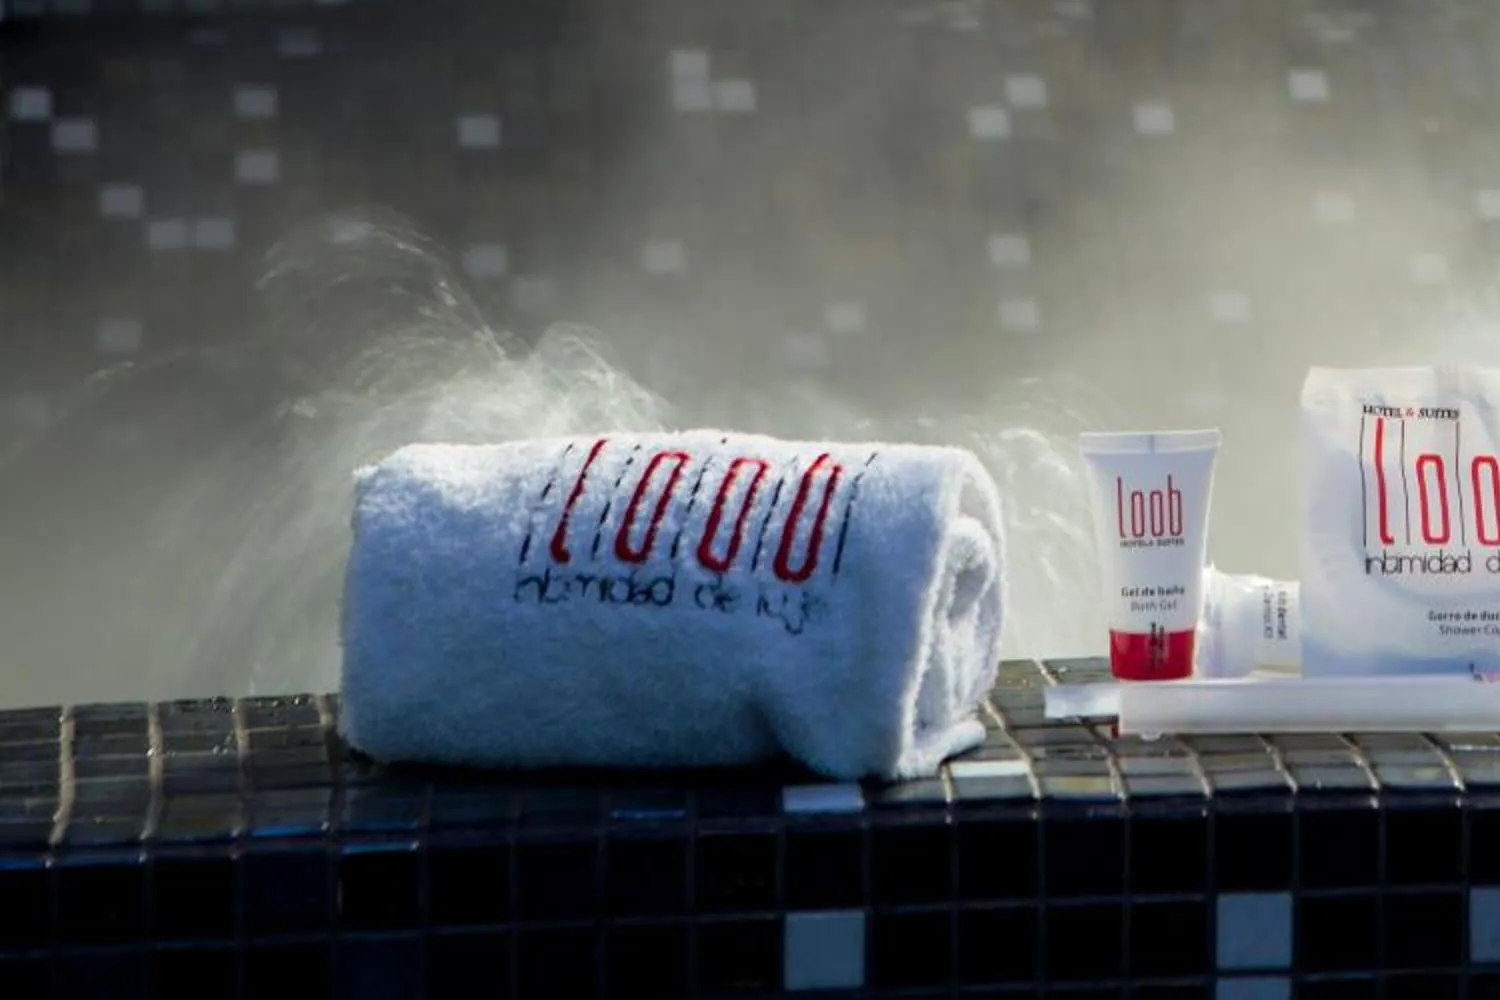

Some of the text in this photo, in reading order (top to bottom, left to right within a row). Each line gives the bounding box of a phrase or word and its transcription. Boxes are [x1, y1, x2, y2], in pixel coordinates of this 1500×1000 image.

[1363, 405, 1460, 420] HOTEL & SUITES
[1117, 474, 1184, 539] loob
[1364, 550, 1472, 576] intimidad
[1142, 586, 1155, 598] de
[1159, 599, 1177, 611] Gel
[1463, 609, 1478, 621] de
[1439, 624, 1481, 636] Shower
